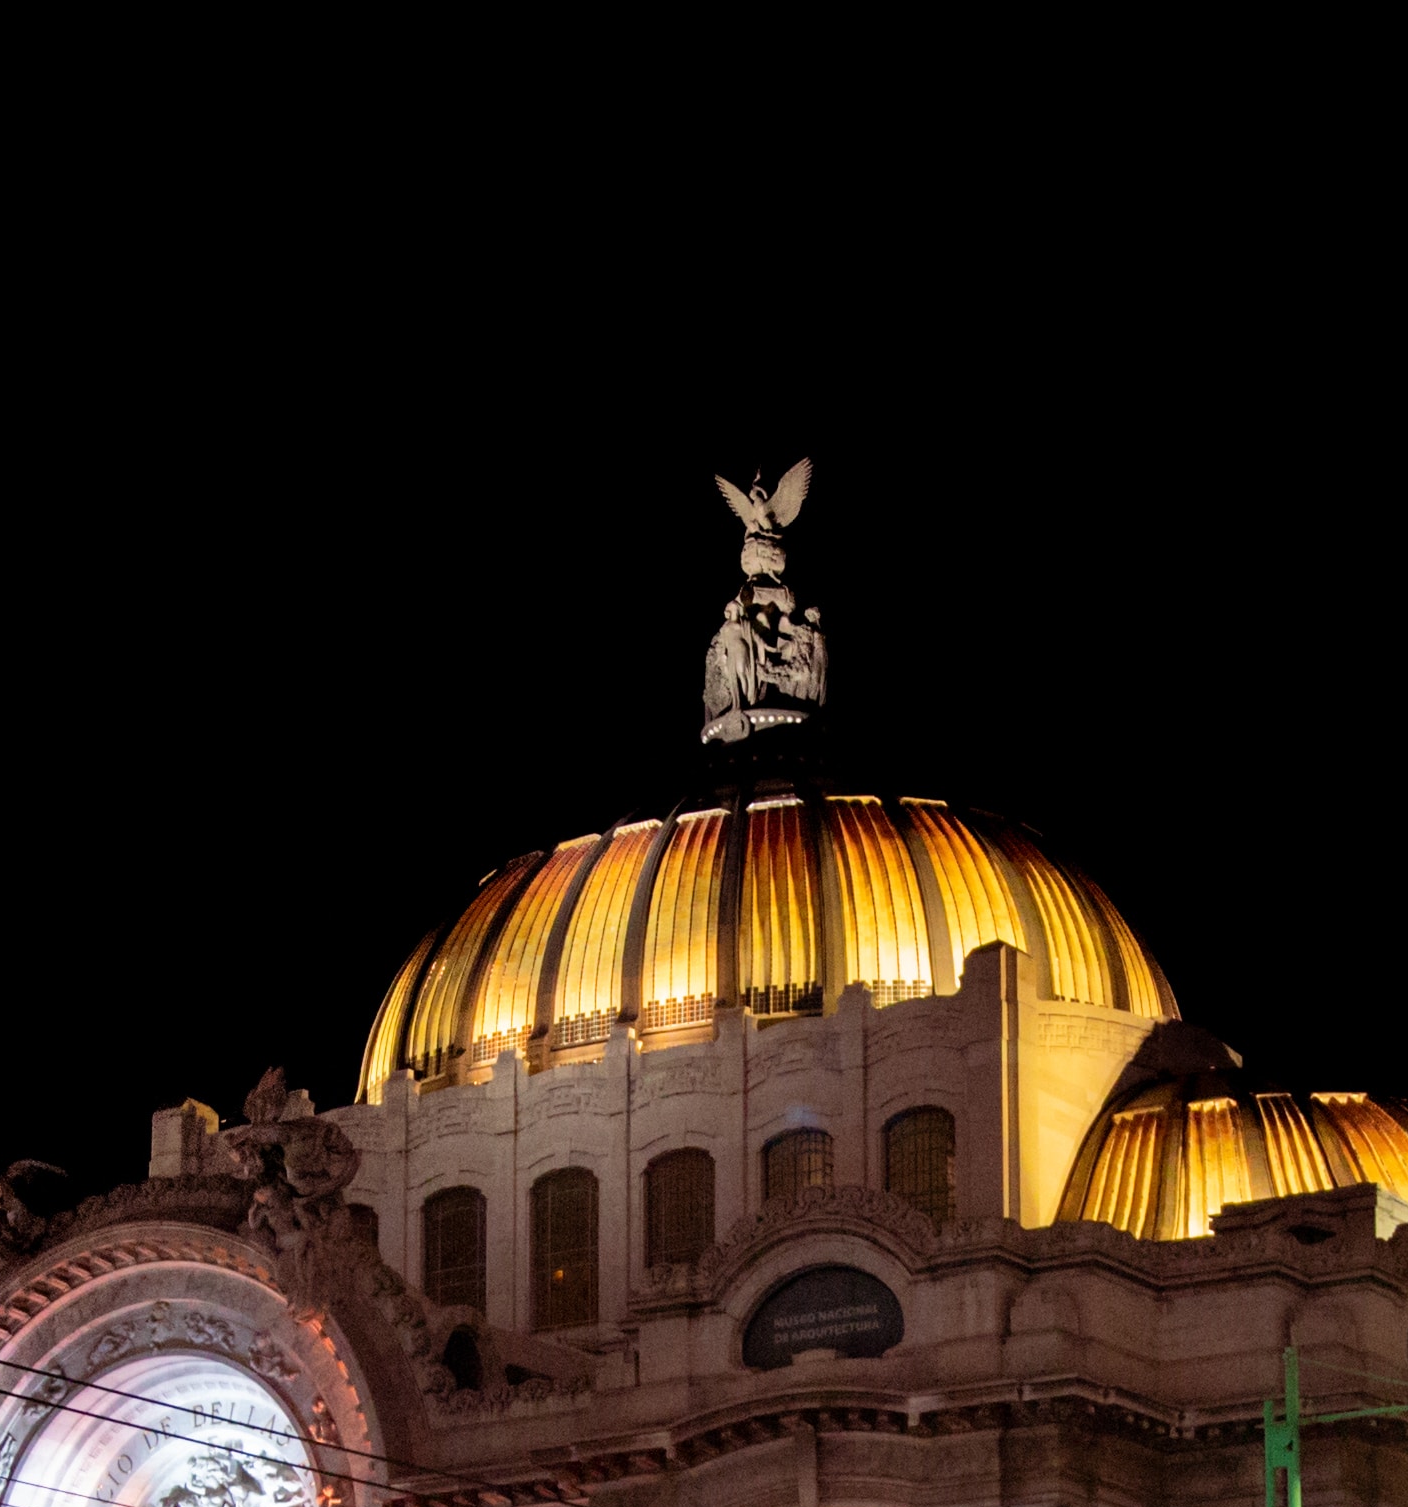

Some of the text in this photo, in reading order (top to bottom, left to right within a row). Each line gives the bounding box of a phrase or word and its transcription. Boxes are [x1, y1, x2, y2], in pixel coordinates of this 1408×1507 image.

[774, 1304, 878, 1328] MUSEO NACIONAL
[142, 1416, 177, 1450] DE
[193, 1401, 294, 1447] BELLAS
